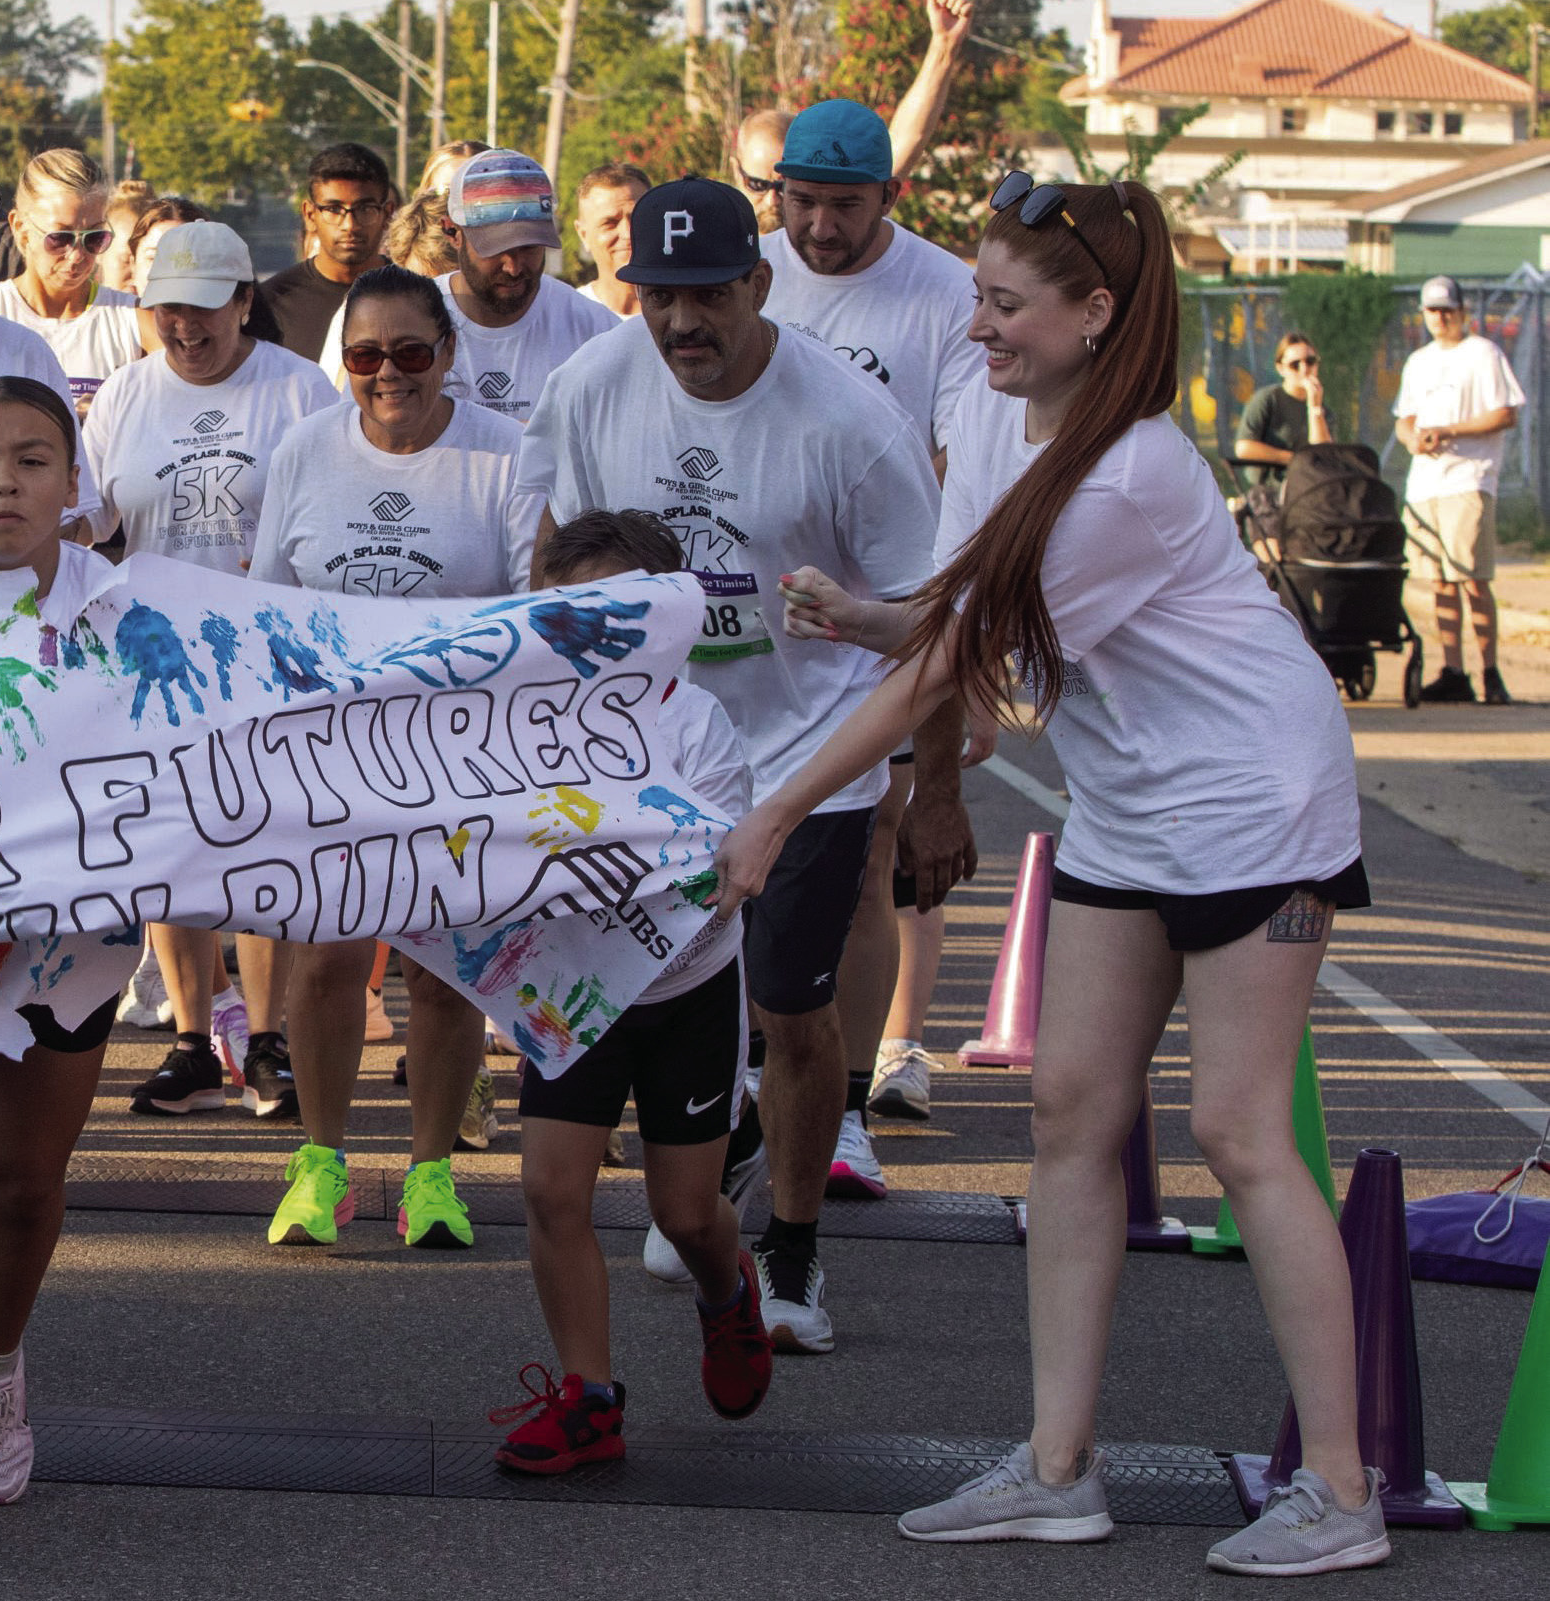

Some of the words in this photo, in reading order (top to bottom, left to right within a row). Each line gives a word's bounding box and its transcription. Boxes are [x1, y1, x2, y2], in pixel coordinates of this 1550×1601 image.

[663, 209, 695, 255] P
[173, 465, 244, 521] 5K
[655, 477, 677, 488] BOYS
[678, 481, 686, 489] &
[688, 482, 710, 492] GIRLS
[711, 488, 738, 501] CLUBS
[680, 494, 710, 505] OKLAHOMA
[159, 524, 188, 540] FOR
[190, 518, 256, 535] FUTURES
[215, 532, 246, 546] RUN
[347, 522, 368, 530] BOYS
[378, 524, 401, 532] GIRLS
[403, 526, 430, 534] CLUBS
[714, 579, 753, 589] Timing
[60, 673, 653, 871] FUTURES
[211, 815, 495, 945] RUN
